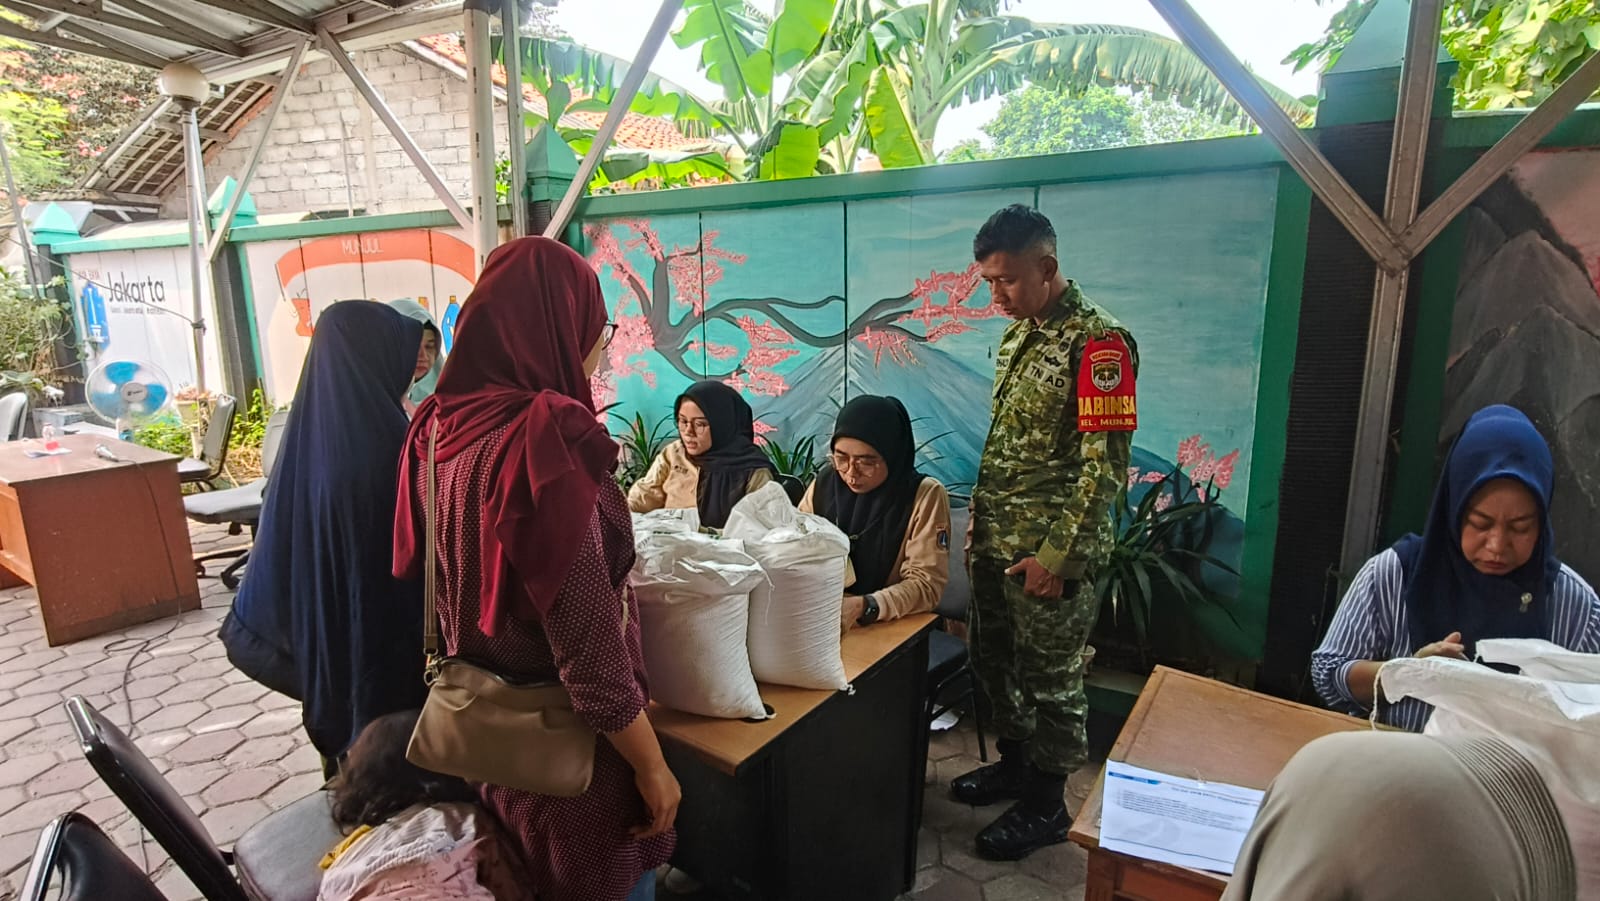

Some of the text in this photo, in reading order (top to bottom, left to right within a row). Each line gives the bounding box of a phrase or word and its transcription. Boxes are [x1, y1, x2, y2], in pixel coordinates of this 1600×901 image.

[107, 271, 165, 303] Jakarta
[1030, 365, 1065, 388] TN AD
